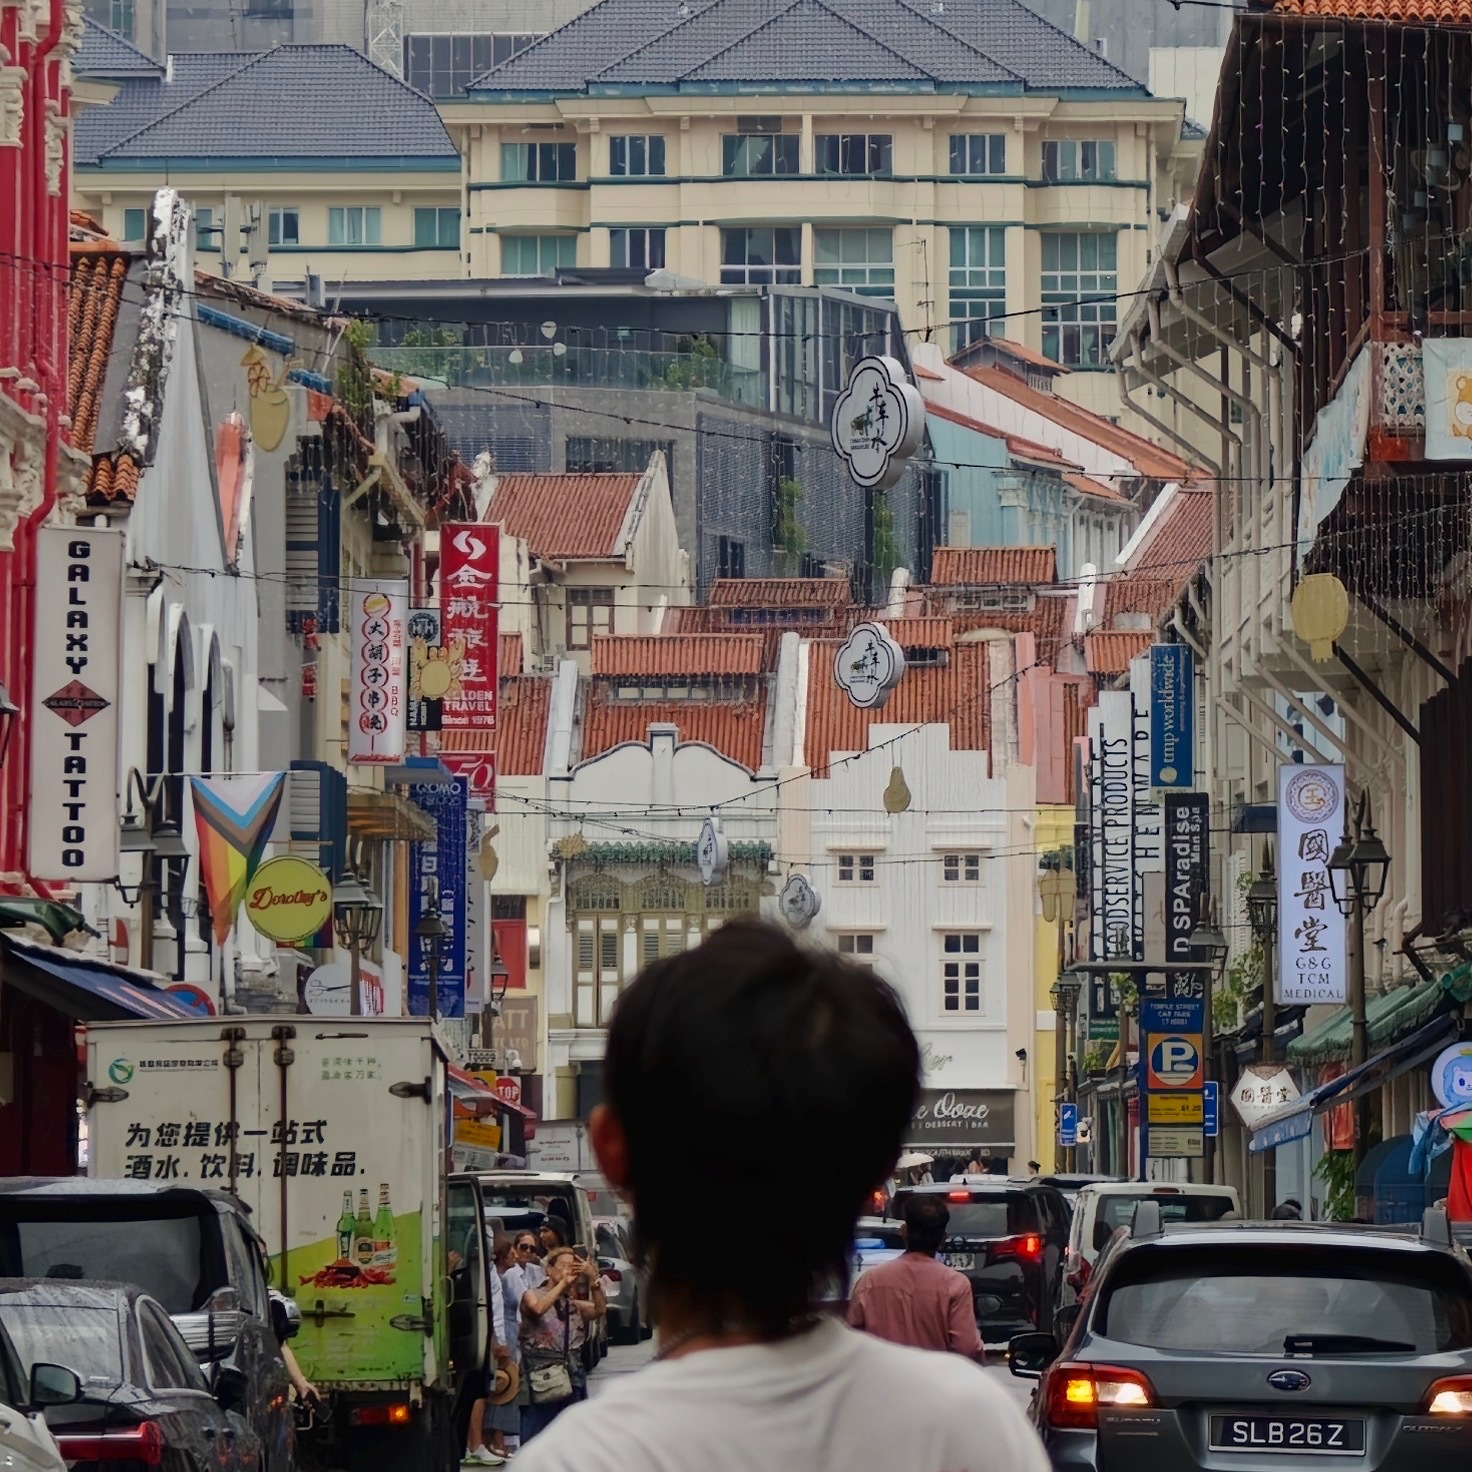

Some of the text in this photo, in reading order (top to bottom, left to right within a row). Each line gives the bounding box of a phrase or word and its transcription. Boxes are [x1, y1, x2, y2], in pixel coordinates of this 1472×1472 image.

[62, 540, 91, 868] GALAXY TATTOO
[443, 700, 493, 712] TRAVEL
[1103, 738, 1129, 828] PRODUCTS
[1172, 806, 1192, 930] SPAradise
[1294, 828, 1331, 953] 國醫堂
[1295, 957, 1331, 970] G&G
[1297, 972, 1330, 985] TCM
[1283, 989, 1343, 999] MEDICAL
[497, 1085, 519, 1102] TOP
[125, 1120, 328, 1148] 为您提供一站式
